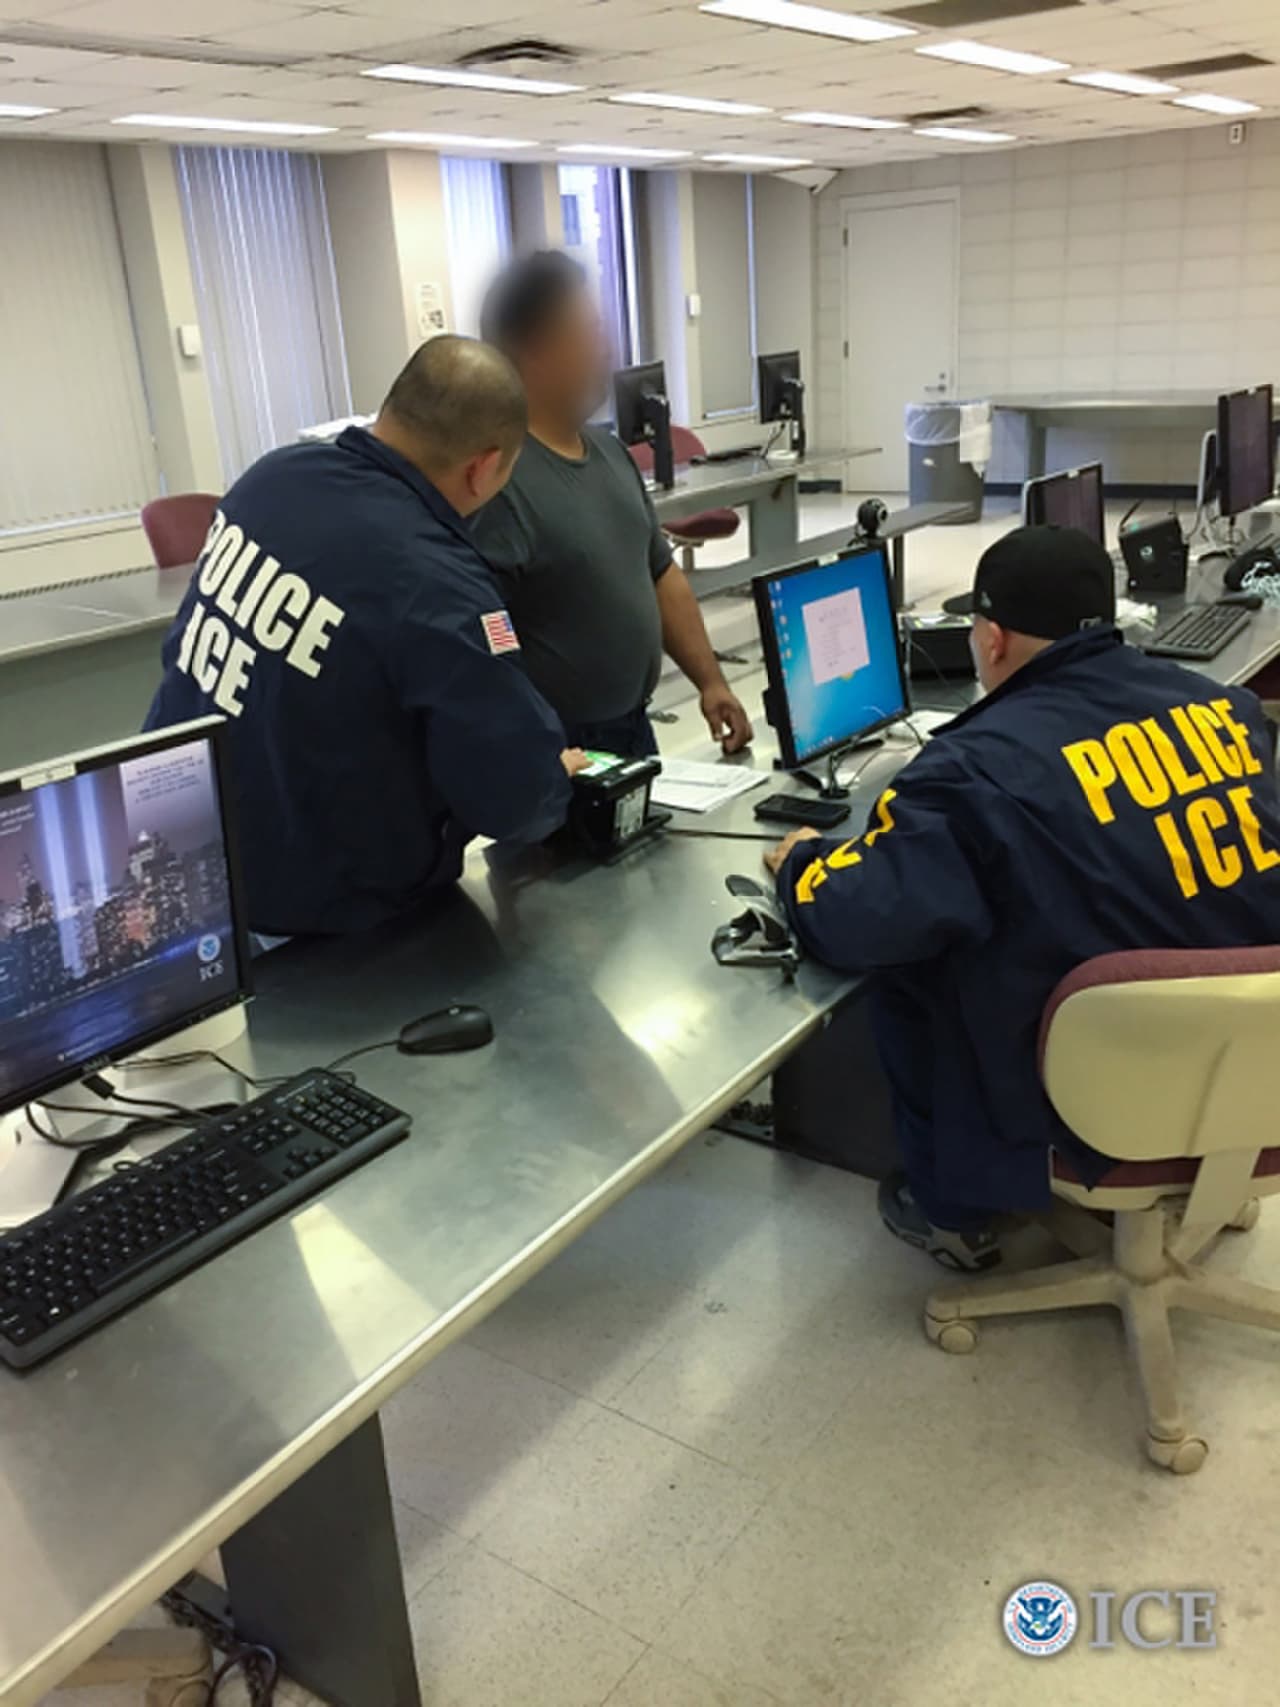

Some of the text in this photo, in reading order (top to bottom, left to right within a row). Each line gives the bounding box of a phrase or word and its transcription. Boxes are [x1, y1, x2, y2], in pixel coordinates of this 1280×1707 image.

[198, 509, 345, 678] POLICE
[176, 601, 257, 717] ICE
[1061, 698, 1263, 824] POLICE
[1154, 785, 1280, 899] ICE
